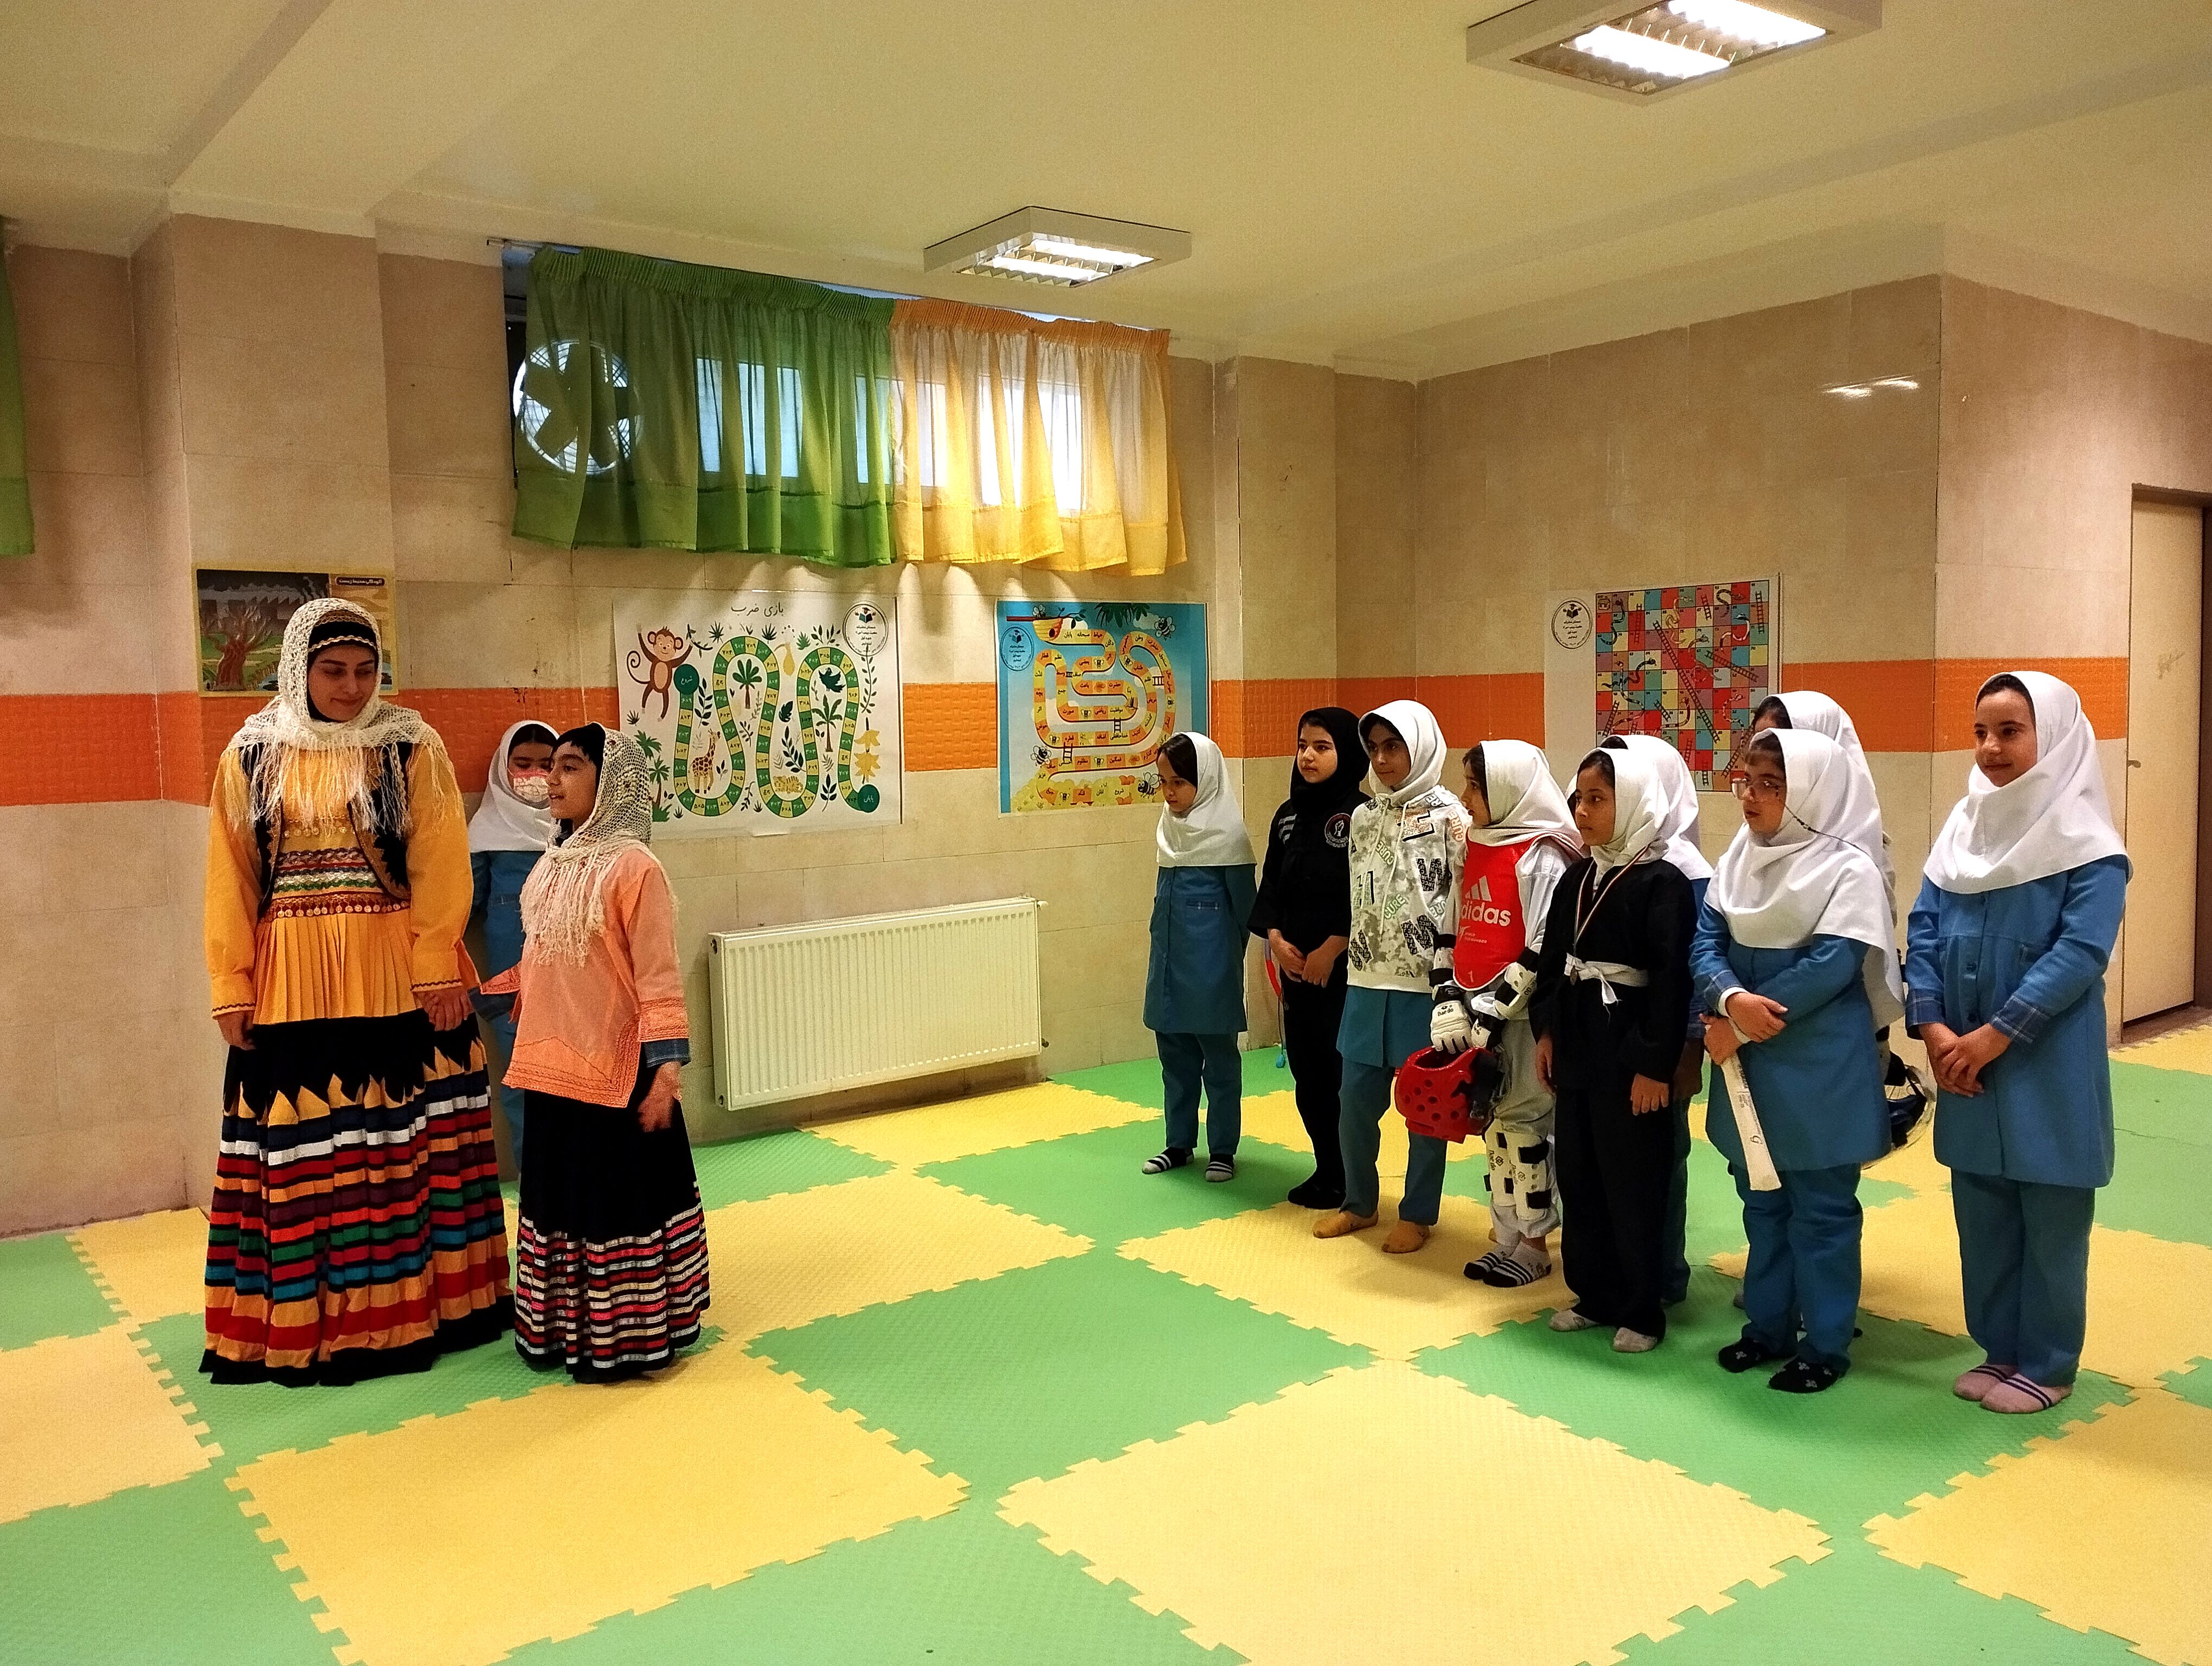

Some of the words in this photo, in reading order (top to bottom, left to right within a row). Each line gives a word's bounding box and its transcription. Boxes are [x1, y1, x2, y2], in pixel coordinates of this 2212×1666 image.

[731, 603, 759, 616] ضرب
[764, 601, 783, 617] بازی
[680, 675, 693, 685] شروع
[863, 794, 874, 803] پایان
[1448, 811, 1464, 842] CURE
[1376, 841, 1394, 865] CURE
[1384, 894, 1406, 919] CURE
[1461, 901, 1512, 926] didas
